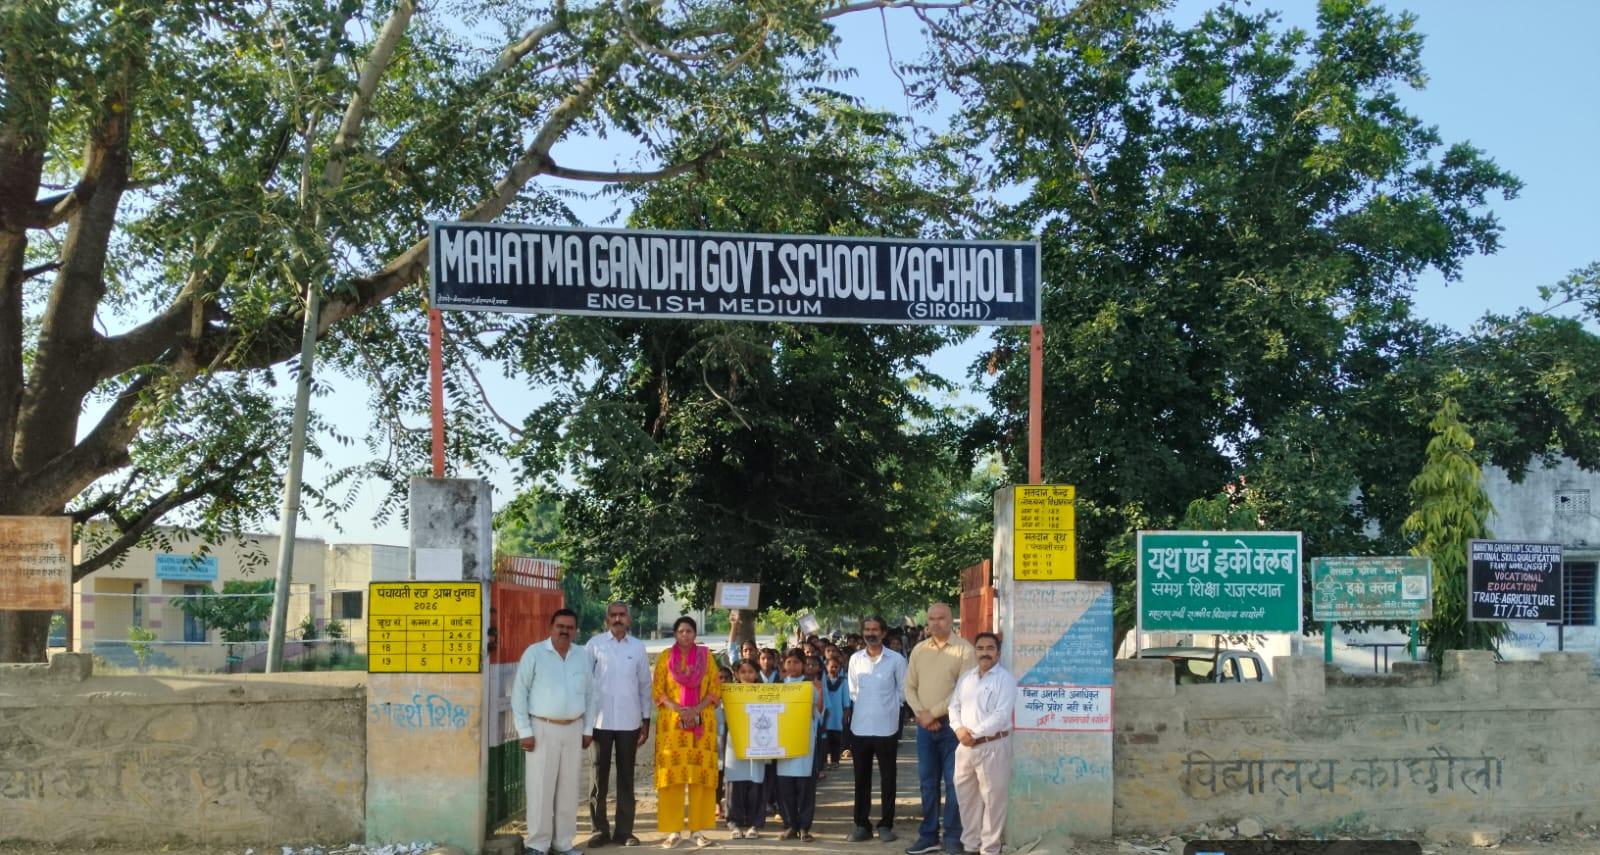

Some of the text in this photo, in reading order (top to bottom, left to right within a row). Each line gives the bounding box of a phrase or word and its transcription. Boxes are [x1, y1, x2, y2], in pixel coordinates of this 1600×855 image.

[439, 229, 585, 287] MAHATMA
[589, 235, 696, 291] GANDHI
[890, 246, 1023, 303] KACHHOLI
[587, 293, 822, 315] ENGLISH MEDIUM
[907, 302, 991, 320] (SIROHI)
[1024, 488, 1049, 497] मतदान
[1147, 539, 1296, 580] यूथ एवं इको क्लब
[1473, 553, 1500, 561] NATIONAL
[1516, 553, 1560, 562] QUALIFICATION
[1494, 572, 1544, 582] VOCATIONAL
[1150, 577, 1285, 600] समग्र शिक्षा राजस्थान
[1487, 582, 1537, 591] EDUCATION
[414, 602, 438, 610] 2026
[382, 643, 391, 652] 18
[1023, 687, 1038, 697] बिना
[1042, 688, 1065, 700] अनुमति
[1181, 749, 1341, 798] विद्यालय
